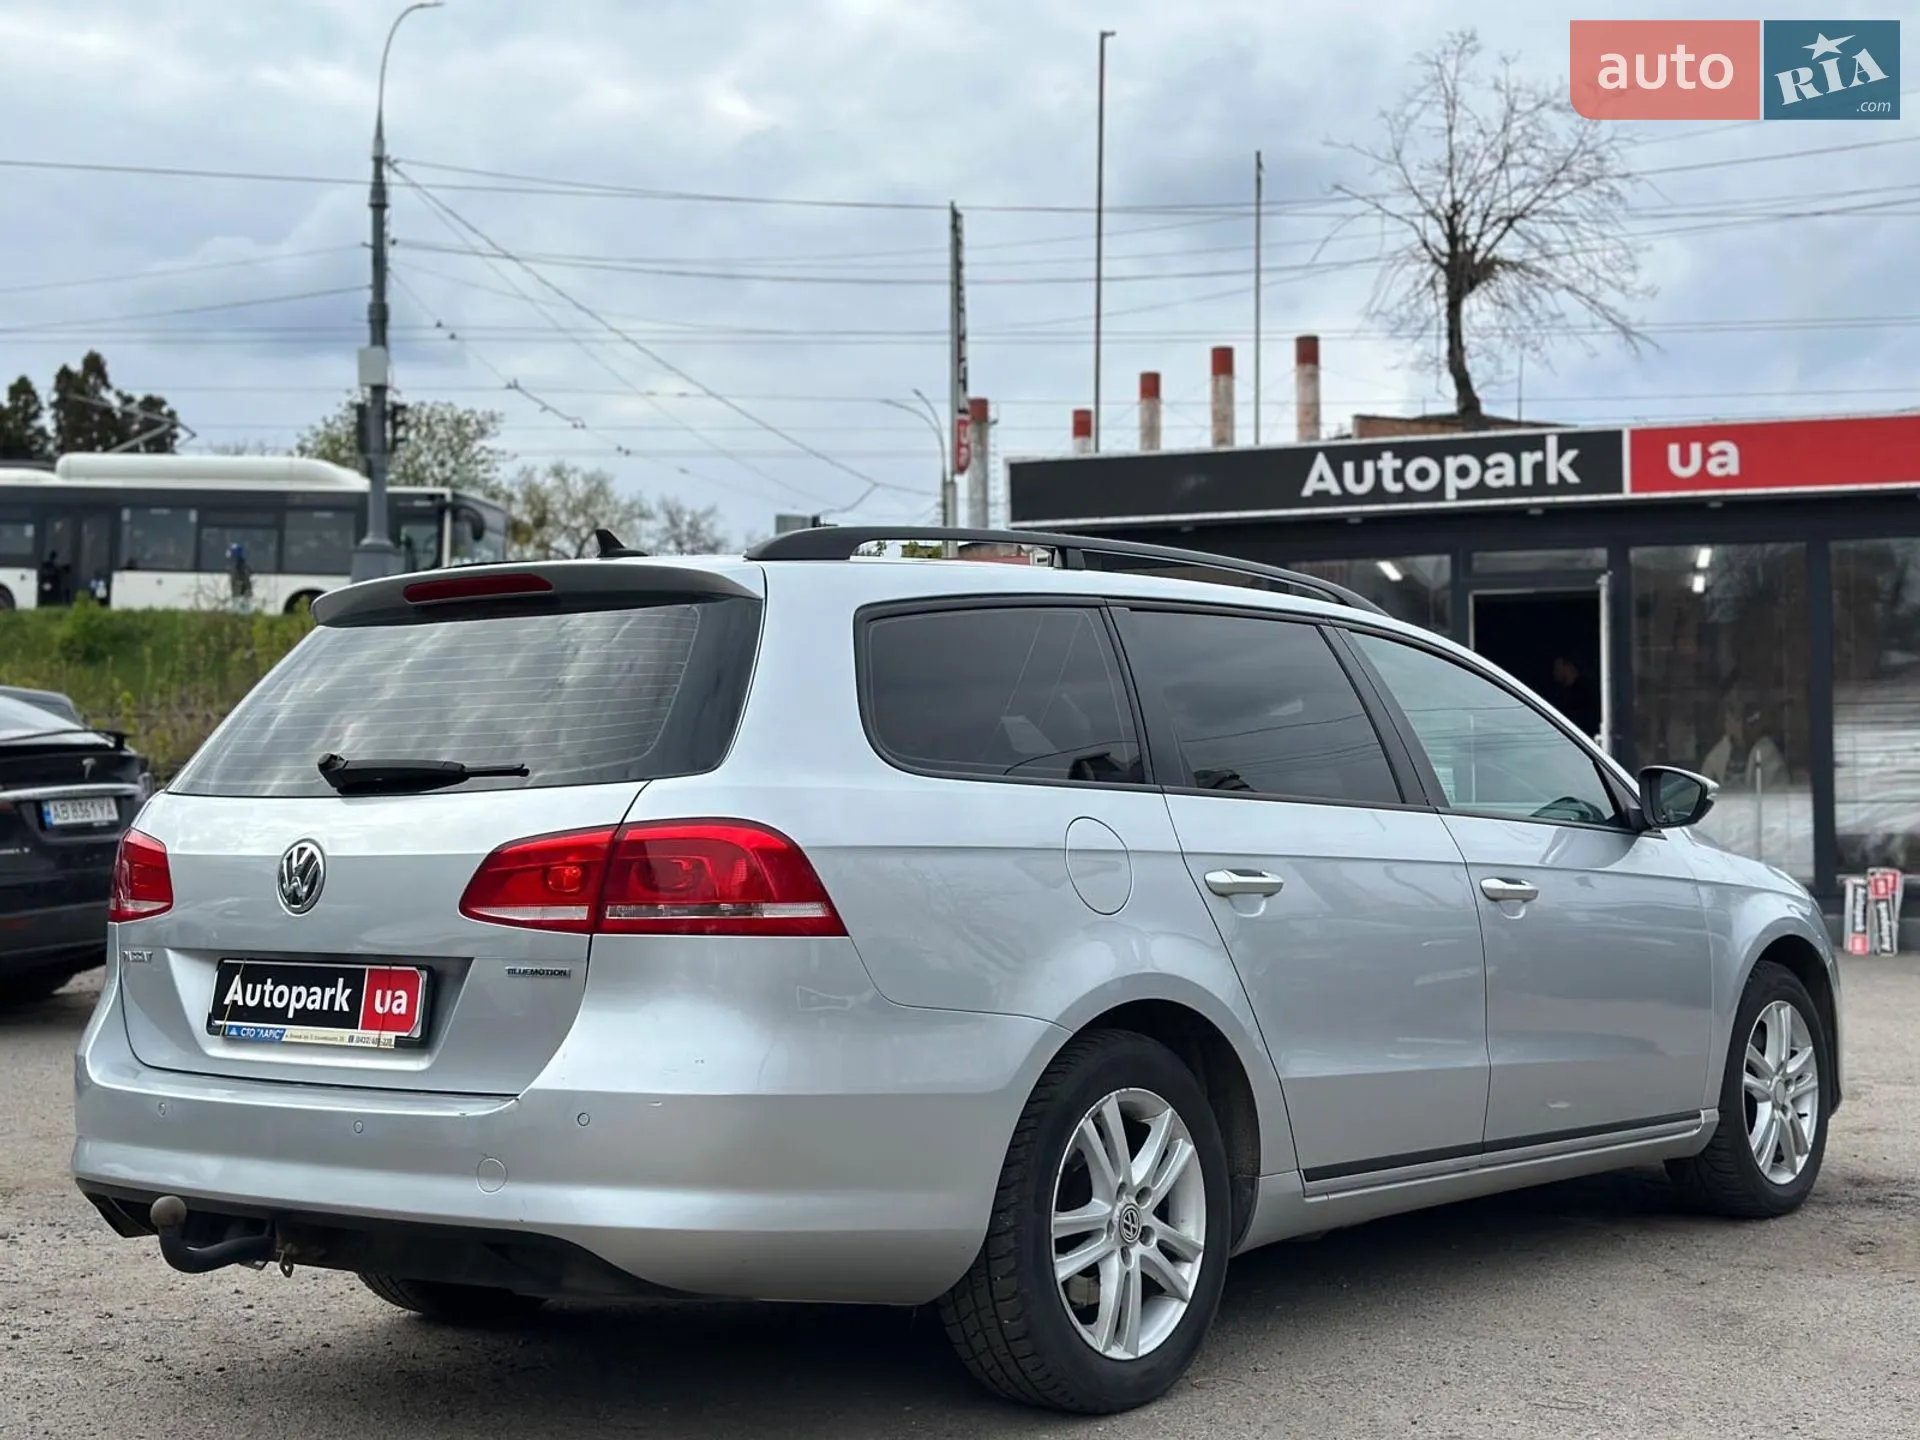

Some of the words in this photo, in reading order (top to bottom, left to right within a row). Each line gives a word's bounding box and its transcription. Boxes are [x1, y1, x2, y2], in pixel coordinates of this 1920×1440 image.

[1300, 434, 1581, 500] Autopark
[1667, 440, 1741, 478] ua
[53, 803, 70, 820] AB
[223, 974, 353, 1018] Autopark
[374, 988, 409, 1015] ua
